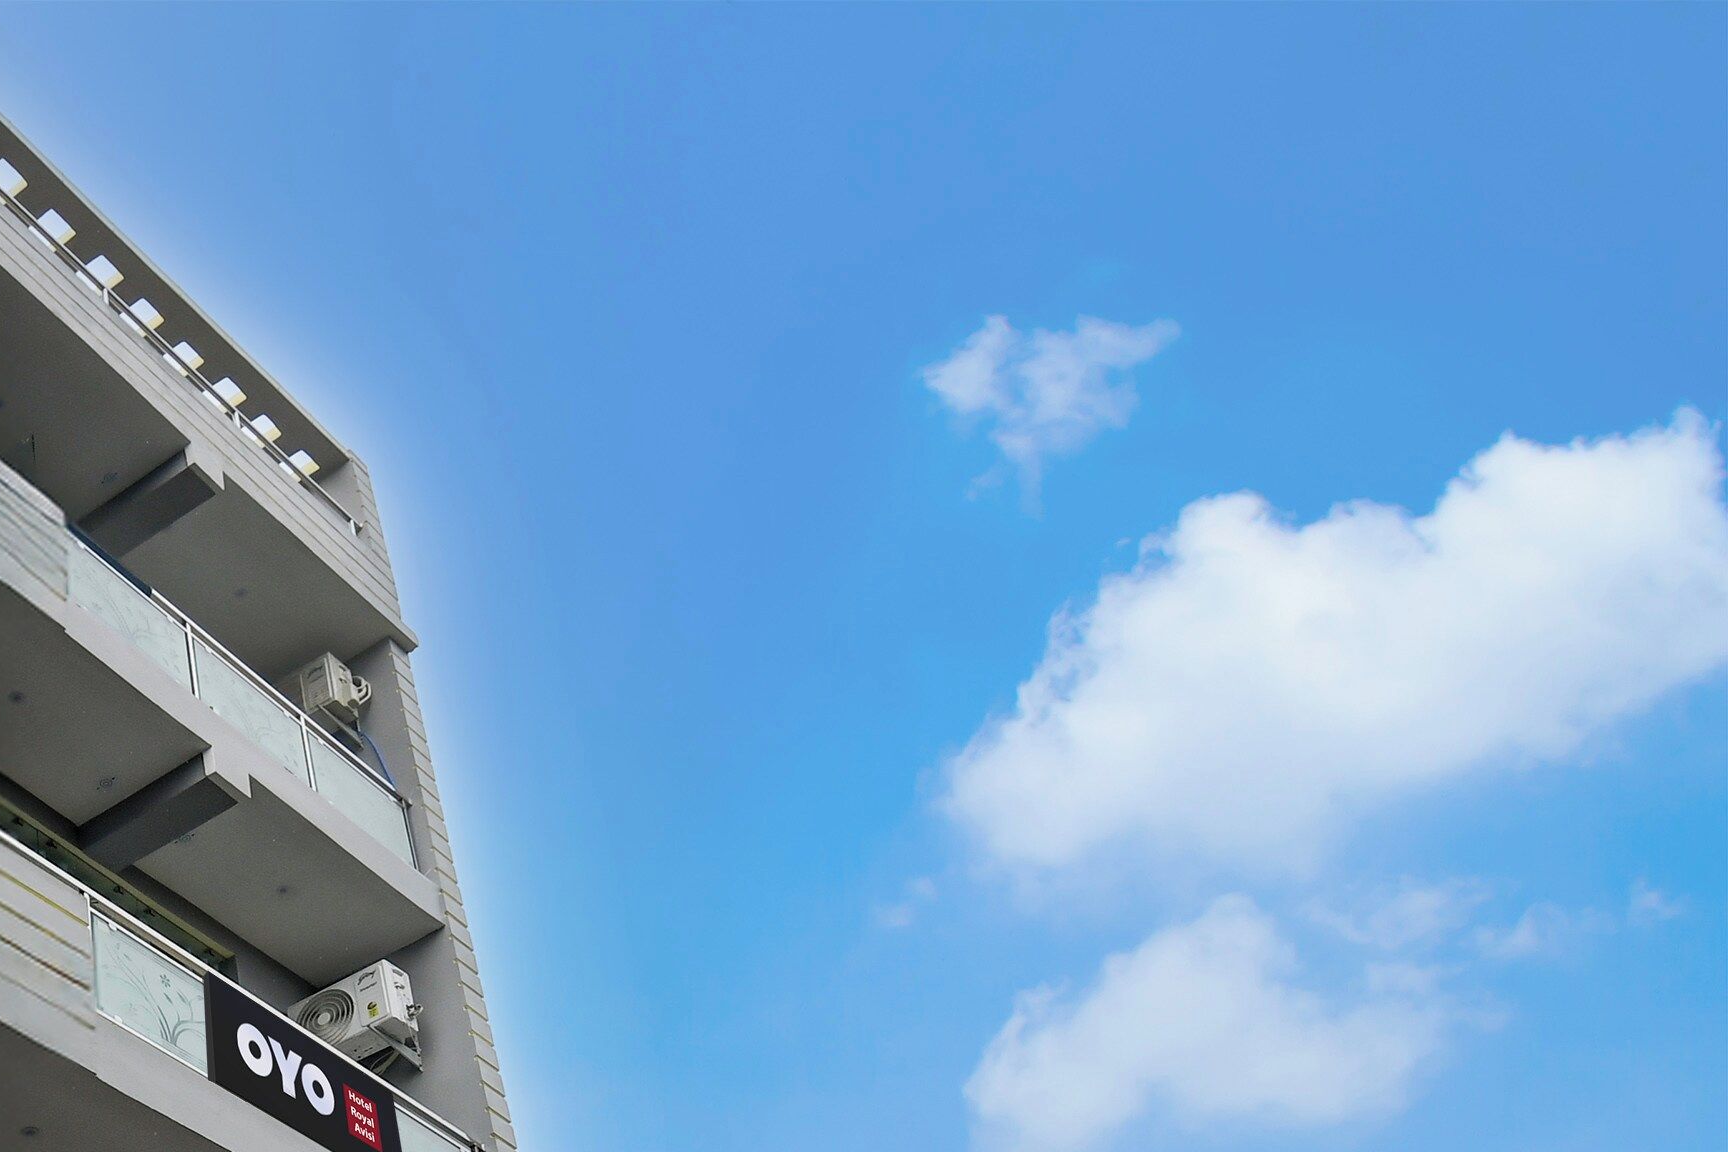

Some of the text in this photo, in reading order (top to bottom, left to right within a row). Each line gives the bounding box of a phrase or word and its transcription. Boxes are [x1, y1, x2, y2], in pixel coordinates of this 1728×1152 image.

[236, 1022, 335, 1116] OYO
[348, 1090, 373, 1113] Hotel
[350, 1106, 375, 1129] Royal
[354, 1122, 376, 1143] Avisi
